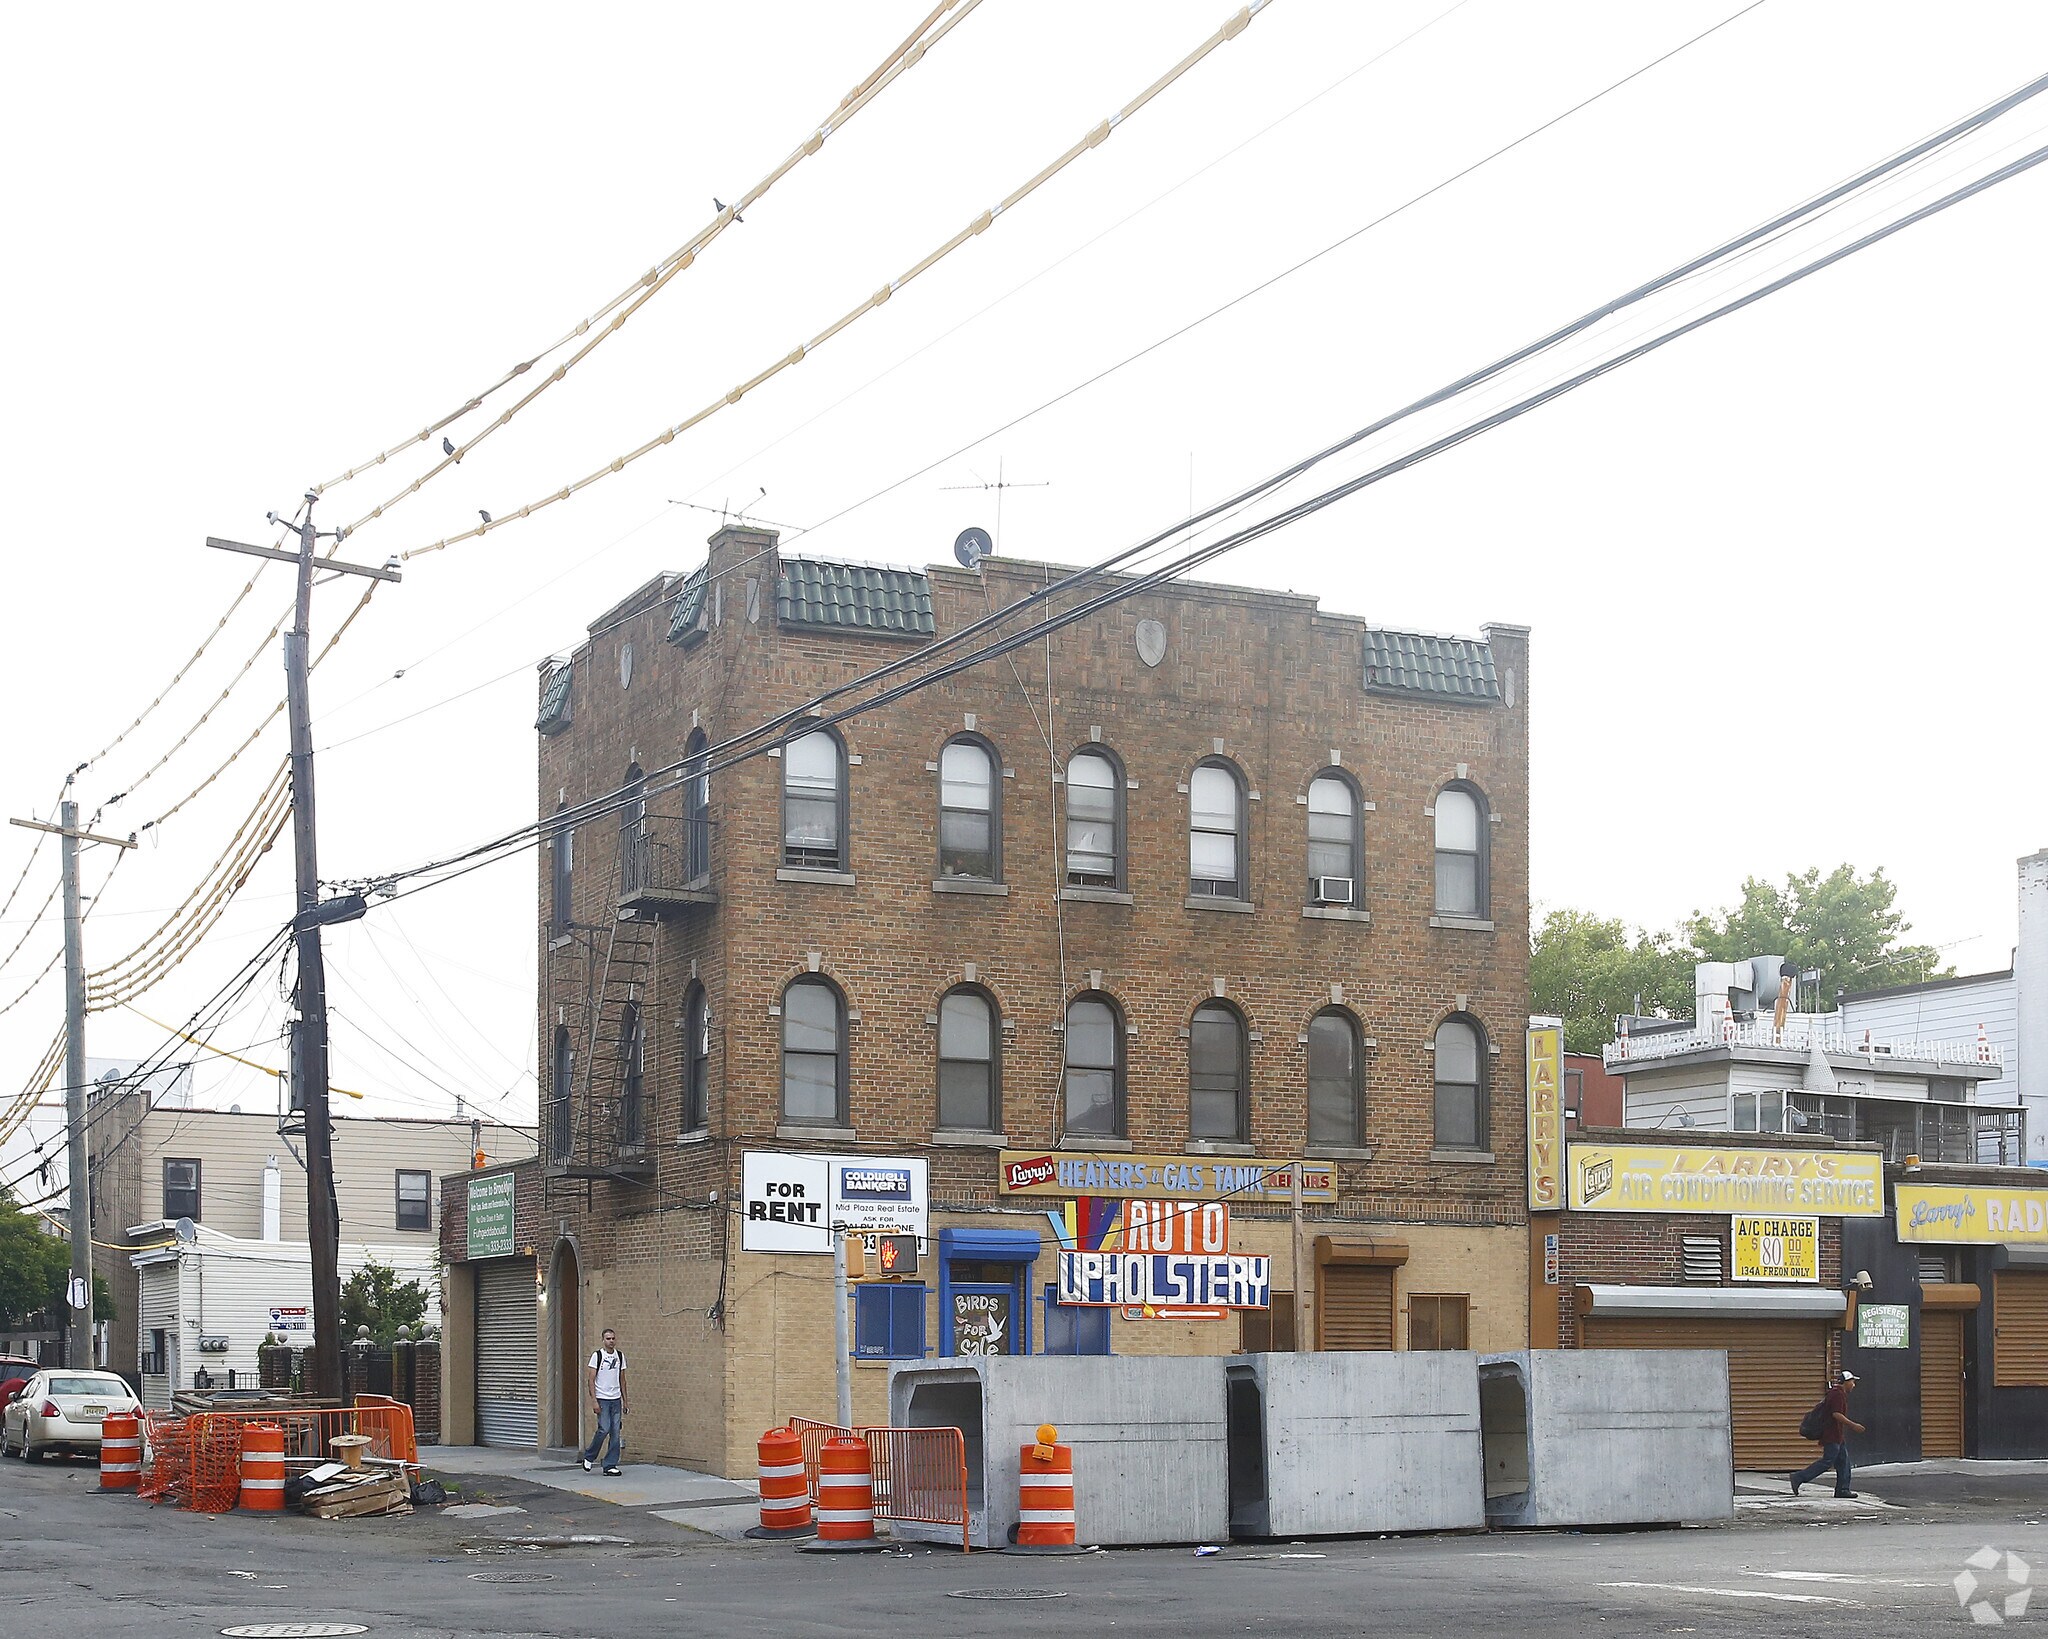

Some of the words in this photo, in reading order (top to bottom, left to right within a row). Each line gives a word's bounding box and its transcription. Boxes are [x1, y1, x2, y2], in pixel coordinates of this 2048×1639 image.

[1533, 1036, 1556, 1204] LARRY'S
[1671, 1153, 1839, 1178] LARRY'S
[845, 1171, 907, 1182] COLDWELL
[1009, 1162, 1053, 1186] Larry's
[1058, 1160, 1147, 1189] HEATERS
[1163, 1163, 1204, 1192] GAS
[1212, 1165, 1264, 1193] TANK
[1268, 1174, 1330, 1188] REIRS
[470, 1185, 488, 1199] Welcome
[493, 1180, 512, 1196] Brooklyn
[766, 1182, 805, 1198] FOR
[846, 1181, 896, 1192] BANKER
[1618, 1172, 1654, 1201] AIR
[1660, 1173, 1795, 1204] CONDITIONING
[1800, 1178, 1875, 1207] SERVICE
[749, 1201, 821, 1222] RENT
[835, 1203, 850, 1211] Mid
[898, 1205, 920, 1213] Estate
[1909, 1194, 1975, 1229] Larry's
[1128, 1200, 1224, 1252] AUTO
[1738, 1220, 1760, 1236] A/C
[1764, 1221, 1813, 1237] CHARGE
[1762, 1237, 1782, 1265] 80
[1058, 1252, 1270, 1307] UPHOLSTERY
[1741, 1266, 1760, 1275] 134A
[1763, 1267, 1789, 1276] FREON
[1791, 1267, 1810, 1277] ONLY
[955, 1295, 999, 1314] BIRDS
[1862, 1307, 1906, 1320] REGISTERED
[963, 1323, 988, 1336] FOR
[1863, 1328, 1883, 1336] MOTOR
[1882, 1328, 1905, 1337] VEHICLE
[960, 1337, 999, 1357] Sale
[1866, 1336, 1886, 1345] REPAIR
[1886, 1336, 1901, 1345] SHOP
